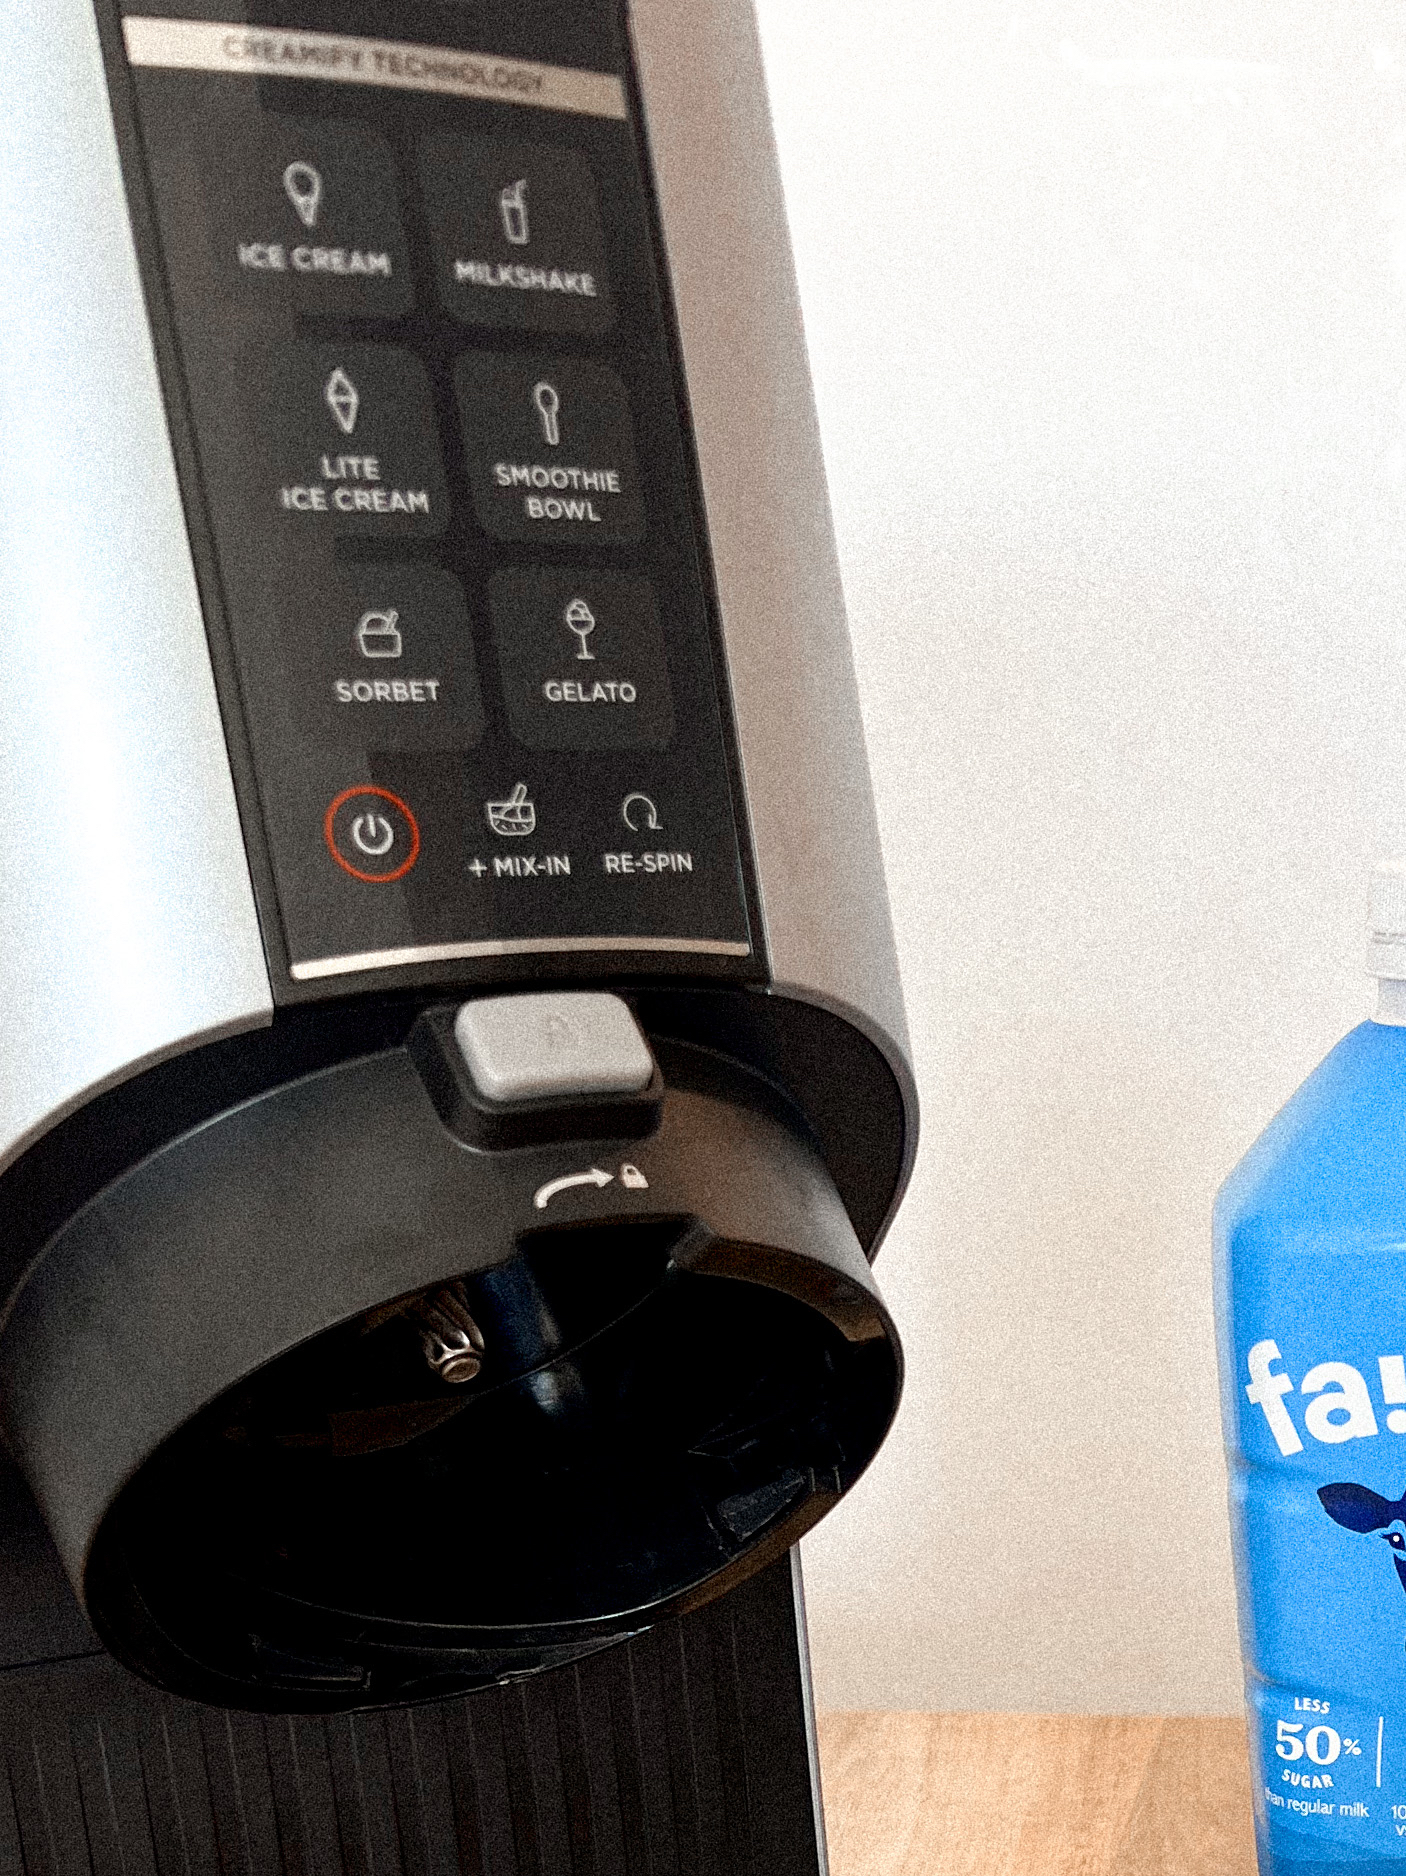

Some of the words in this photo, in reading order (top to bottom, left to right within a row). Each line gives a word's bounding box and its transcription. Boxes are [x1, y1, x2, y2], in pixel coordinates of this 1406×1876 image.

[222, 36, 361, 72] CREAMIFY
[373, 51, 544, 94] TECHNOLOGY
[238, 242, 284, 271] ICE
[293, 245, 391, 277] CREAM
[455, 261, 597, 297] MILKSHAKE
[321, 455, 380, 481] LITE
[495, 463, 622, 494] SMOOTHIE
[281, 487, 327, 512] ICE
[334, 490, 430, 515] CREAM
[527, 496, 602, 523] BOWL
[335, 680, 440, 704] SORBET
[544, 681, 637, 704] GELATO
[493, 856, 571, 878] MIX-IN
[604, 853, 693, 875] RE-SPIN
[1294, 1697, 1331, 1714] LESS
[1275, 1719, 1362, 1766] 50%
[1281, 1768, 1335, 1789] SUGAR
[1287, 1798, 1335, 1817] regular
[1339, 1801, 1370, 1818] milk
